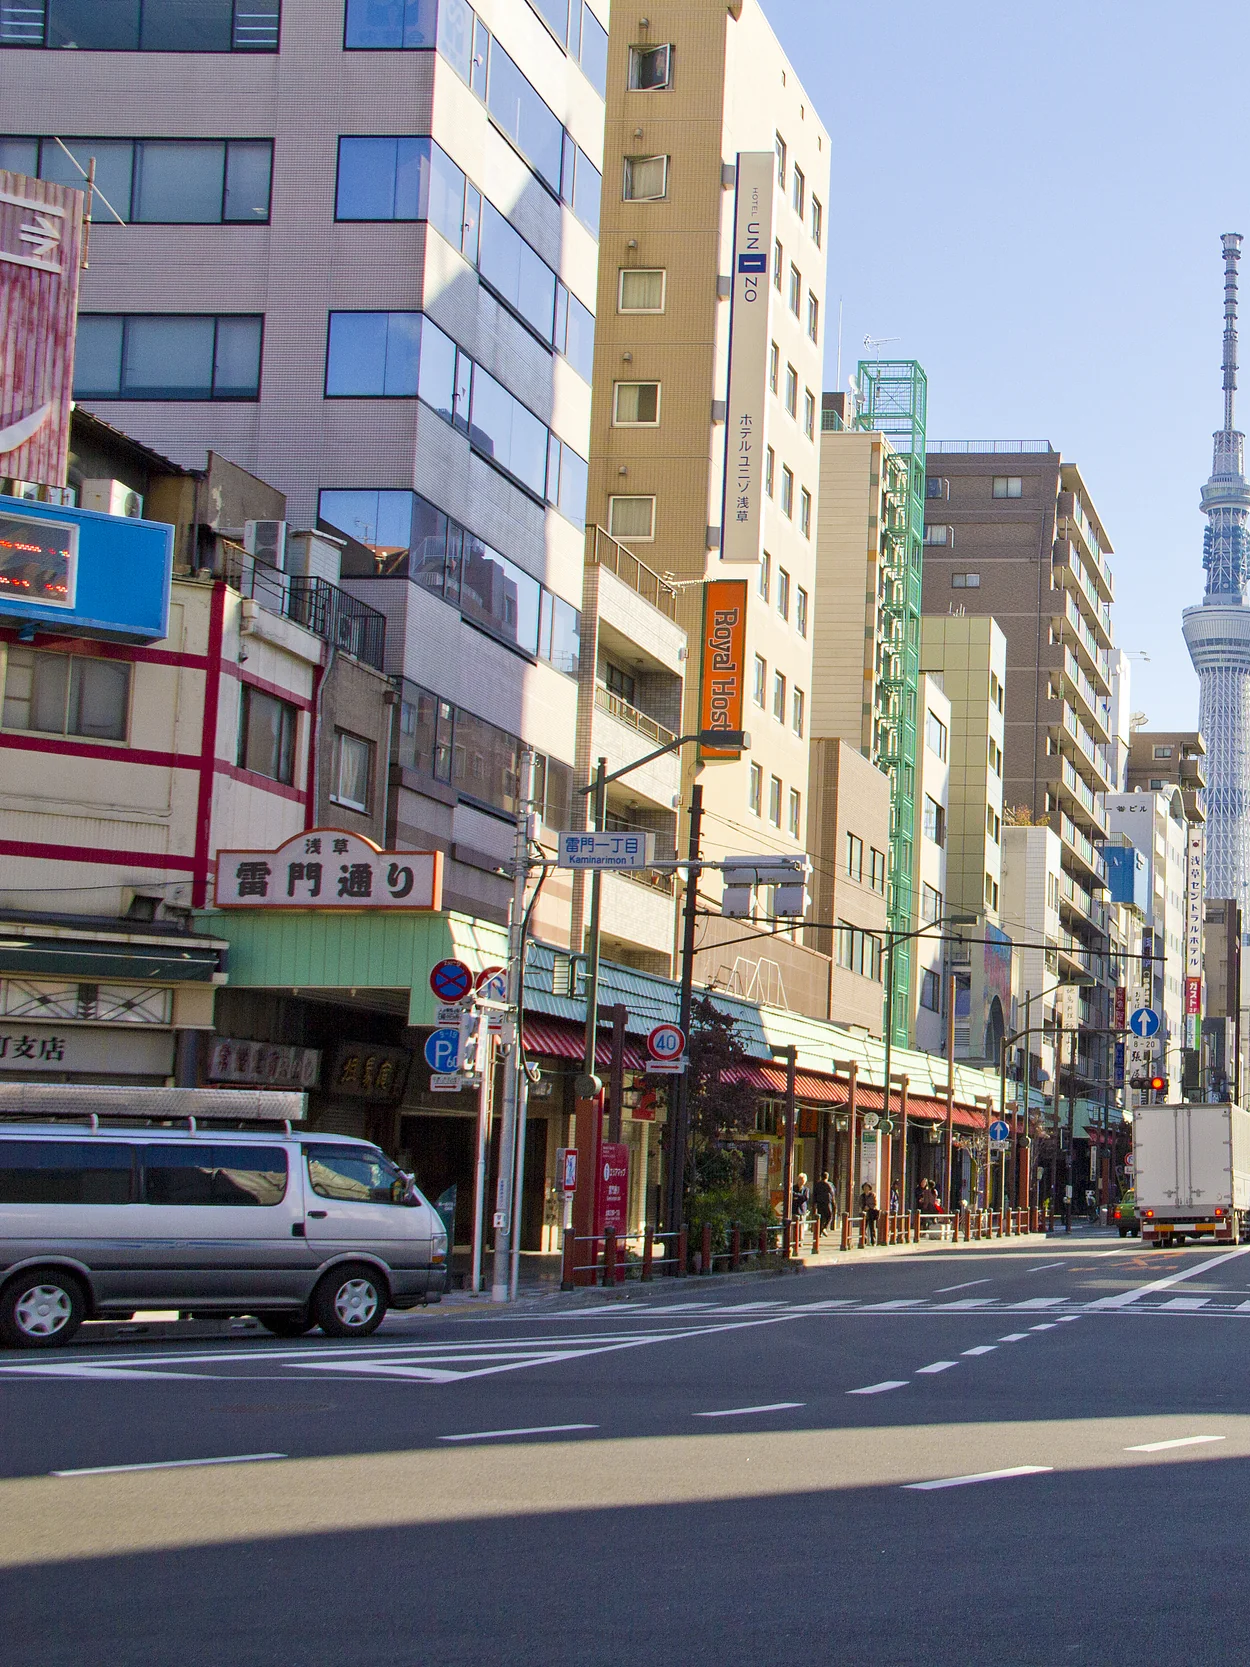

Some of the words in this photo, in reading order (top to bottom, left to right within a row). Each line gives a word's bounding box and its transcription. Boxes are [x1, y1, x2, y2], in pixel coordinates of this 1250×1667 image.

[751, 187, 759, 217] HOTEL
[744, 222, 762, 303] UNIZO
[735, 413, 752, 523] ホテルユニゾ浅草
[708, 607, 740, 672] Royal
[305, 838, 349, 856] 浅草
[565, 837, 638, 854] 雷門一丁目
[569, 855, 627, 865] Kaminarimon
[628, 856, 635, 865] 1
[236, 861, 415, 899] 雷門通り
[1189, 855, 1201, 967] 浅草セントラルホテル
[1189, 982, 1198, 1008] ガスト
[656, 1034, 677, 1051] 40
